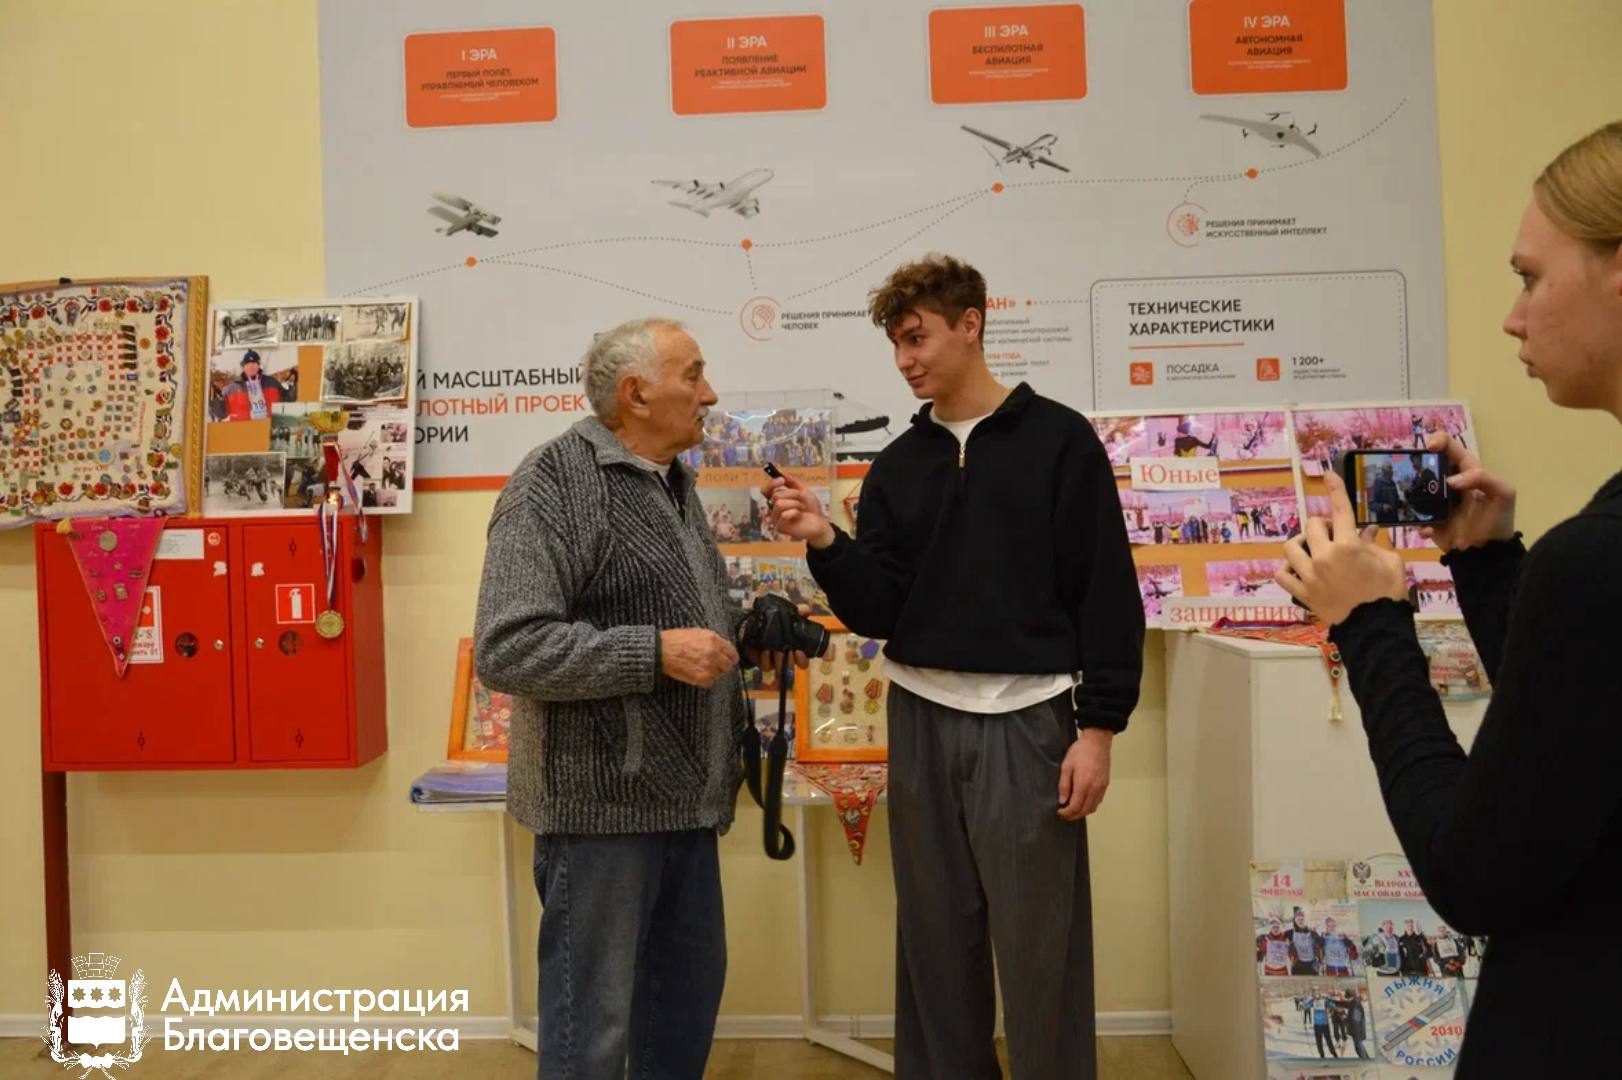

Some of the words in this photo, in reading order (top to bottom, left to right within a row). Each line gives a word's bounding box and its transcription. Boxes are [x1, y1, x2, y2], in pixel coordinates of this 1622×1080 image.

[1243, 16, 1257, 28] IV
[1261, 15, 1290, 28] ЭРА
[984, 26, 996, 38] III
[1000, 24, 1028, 37] ЭРА
[739, 35, 767, 48] ЭРА
[1235, 33, 1303, 45] АВТОНОМНАЯ
[469, 48, 497, 61] ЭРА
[973, 43, 1044, 54] БЕСПИЛОТНАЯ
[1247, 46, 1293, 56] АВИАЦИЯ
[722, 54, 778, 64] ПОЯВЛЕНИЕ
[985, 56, 1031, 65] АВИАЦИЯ
[695, 66, 758, 77] РЕАКТИВНОЙ
[760, 65, 807, 75] АВИАЦИИ
[421, 79, 484, 91] УПРАВЛЯЕМЫЙ
[486, 77, 539, 88] ЧЕЛОВЕКОМ
[1206, 219, 1245, 228] РЕШЕНИЯ
[1246, 217, 1297, 227] ПРИНИМАЕТ
[1206, 229, 1279, 239] ИСКУССТВЕННЫЙ
[1280, 227, 1328, 237] ИНТЕЛЛЕКТ
[1128, 299, 1242, 316] ТЕХНИЧЕСКИЕ
[781, 311, 820, 321] РЕШЕНИЯ
[781, 322, 819, 331] ЧЕЛОВЕК
[1129, 318, 1275, 336] ХАРАКТЕРИСТИКИ
[1166, 362, 1220, 375] ПОСАДКА
[417, 393, 509, 417] ЛОТНЫЙ
[515, 394, 586, 414] ПРОЕК
[1140, 463, 1217, 484] Юные
[1273, 873, 1291, 888] 14
[1384, 976, 1445, 998] ЛЫЖНЯ
[1430, 1025, 1463, 1036] 2010
[1396, 1048, 1457, 1066] РОССИИ
